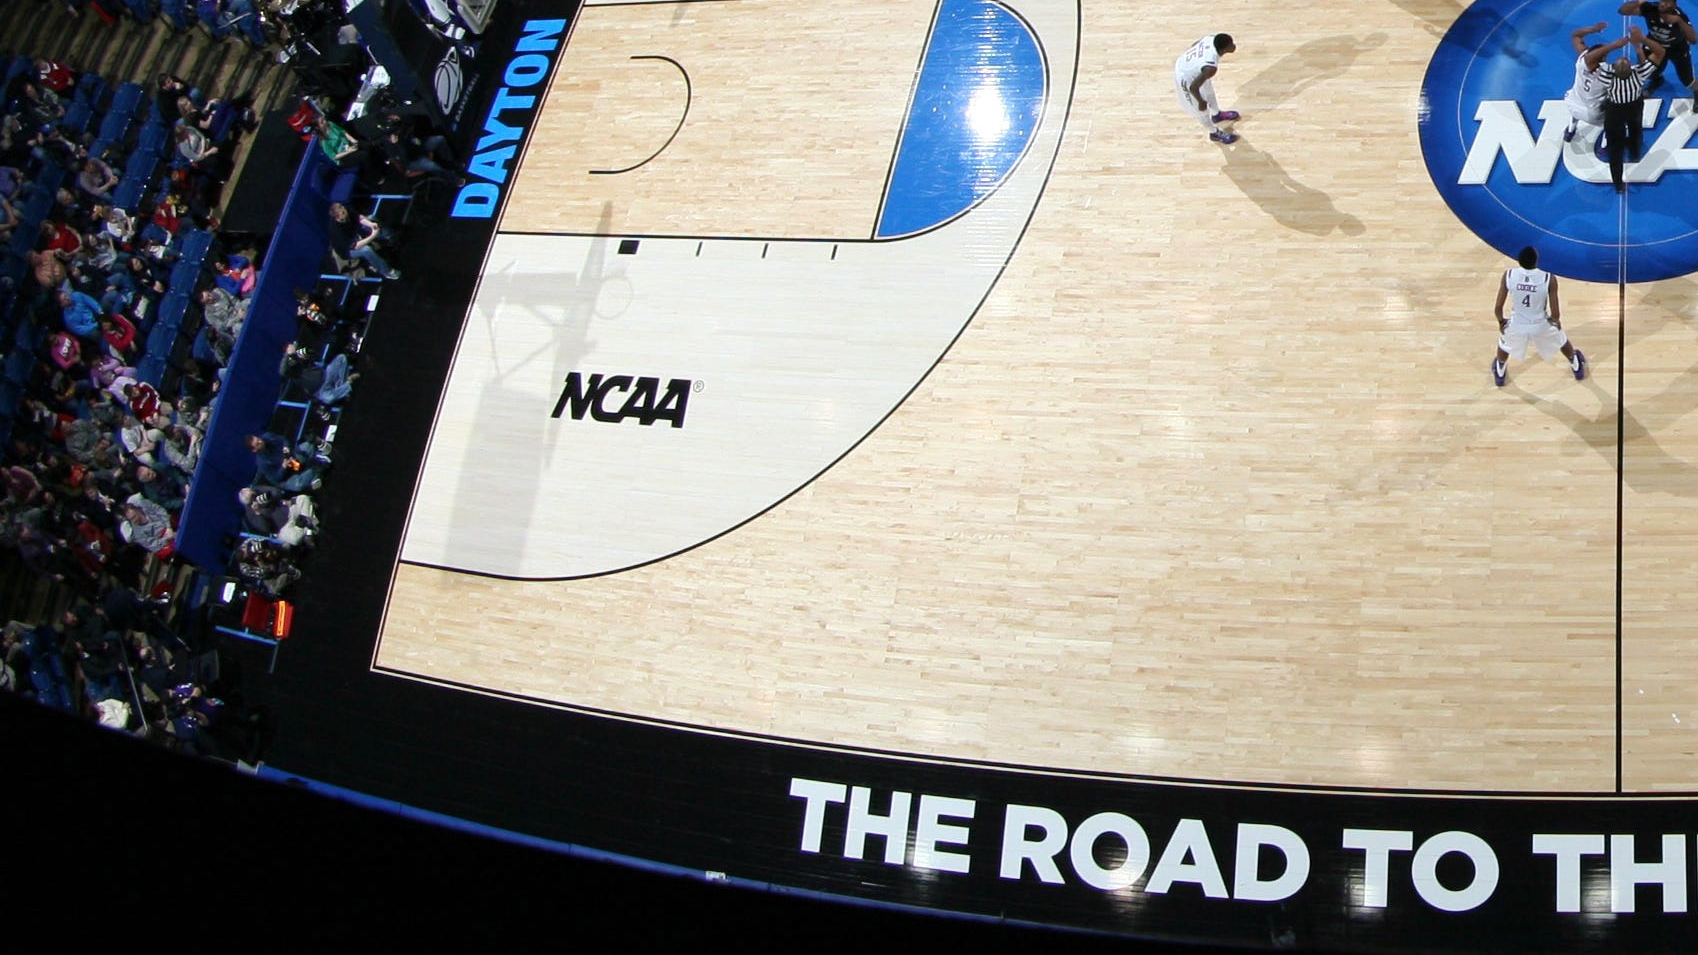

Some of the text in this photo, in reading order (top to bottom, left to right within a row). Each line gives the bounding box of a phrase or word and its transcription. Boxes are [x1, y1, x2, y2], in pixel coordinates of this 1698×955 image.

[451, 18, 567, 218] DAYTON
[1522, 294, 1530, 307] 4
[551, 372, 692, 428] NCAA
[790, 778, 976, 874] THE
[1001, 804, 1310, 903] ROAD
[1342, 828, 1500, 912] TO
